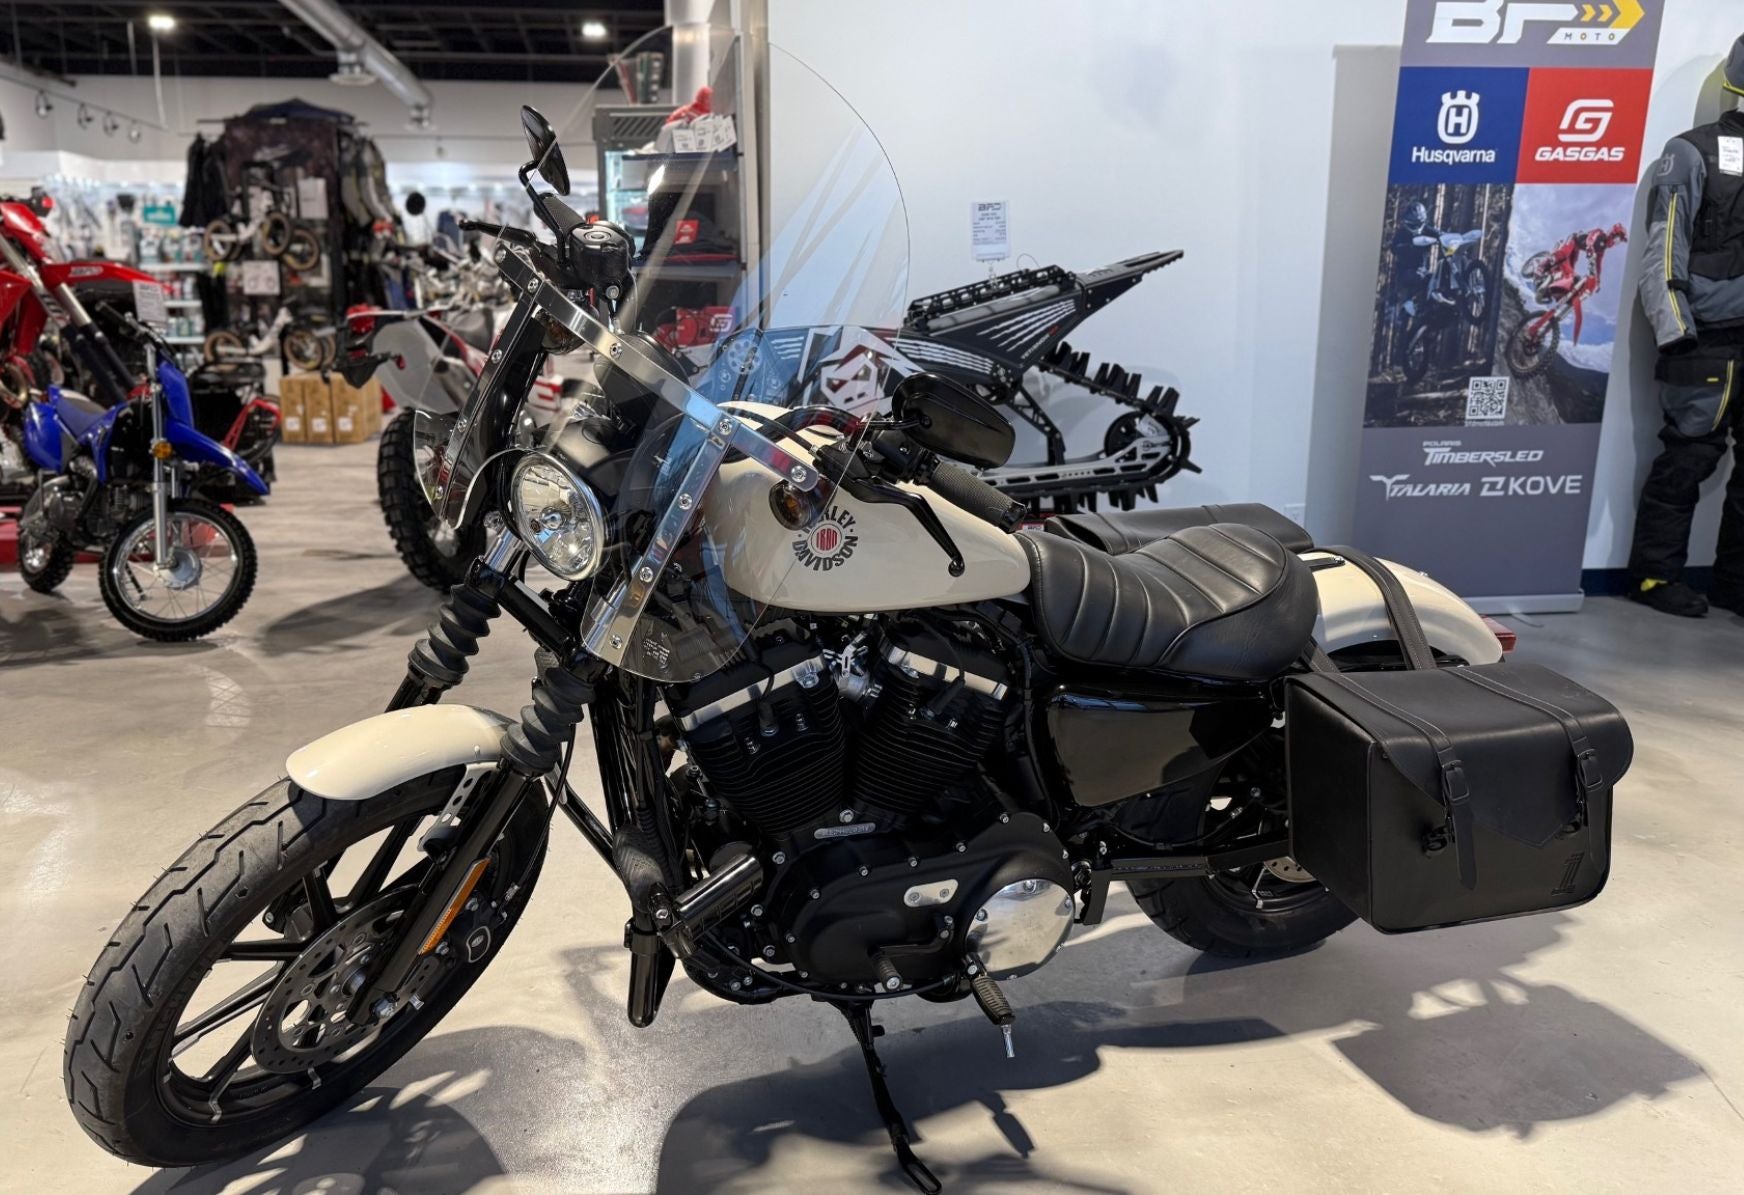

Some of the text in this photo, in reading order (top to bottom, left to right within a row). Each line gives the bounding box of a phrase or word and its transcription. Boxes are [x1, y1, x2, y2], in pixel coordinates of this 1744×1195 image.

[1564, 31, 1616, 41] MOTO
[1411, 146, 1496, 165] Husqvarna
[1534, 146, 1626, 162] GASGAS
[1508, 475, 1583, 496] KOVE
